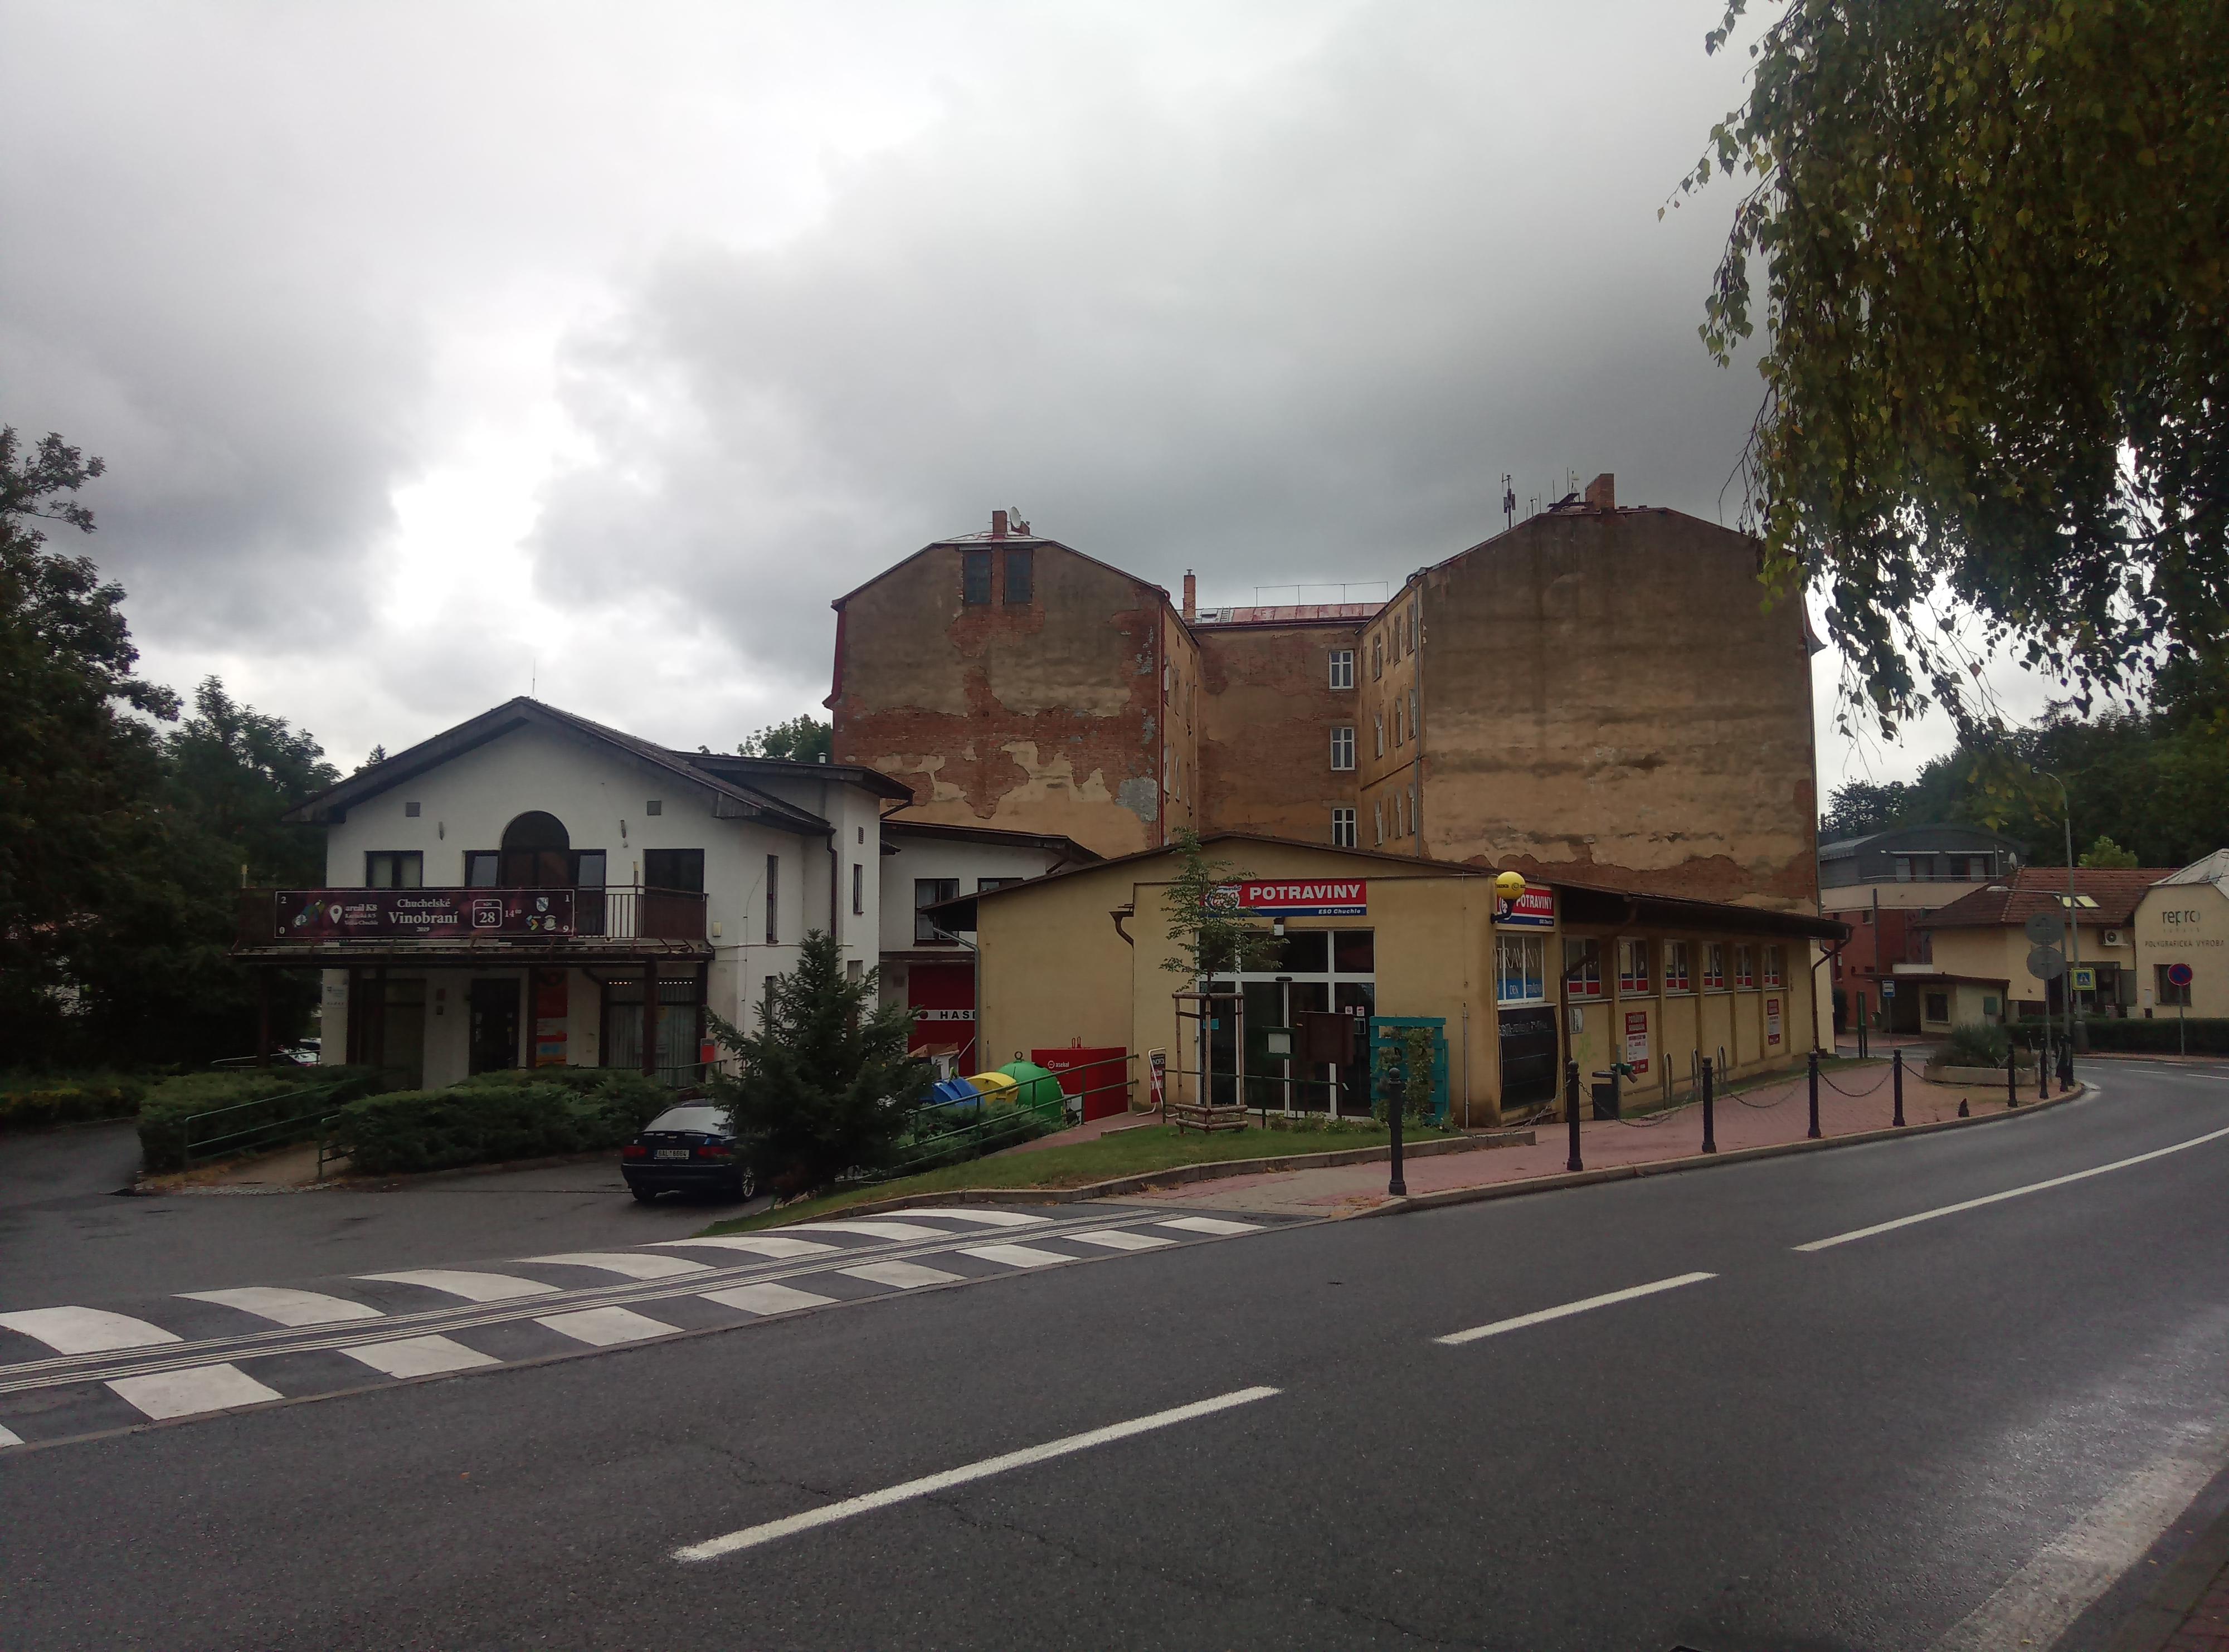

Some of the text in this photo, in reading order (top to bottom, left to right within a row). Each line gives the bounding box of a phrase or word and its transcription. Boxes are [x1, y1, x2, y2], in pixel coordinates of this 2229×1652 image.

[1249, 884, 1361, 900] POTRAVINY
[397, 898, 451, 908] Chuchelské
[1516, 894, 1552, 910] POTRAVINY
[388, 911, 459, 924] Vinobraní
[479, 912, 496, 924] 28
[563, 925, 570, 933] 9
